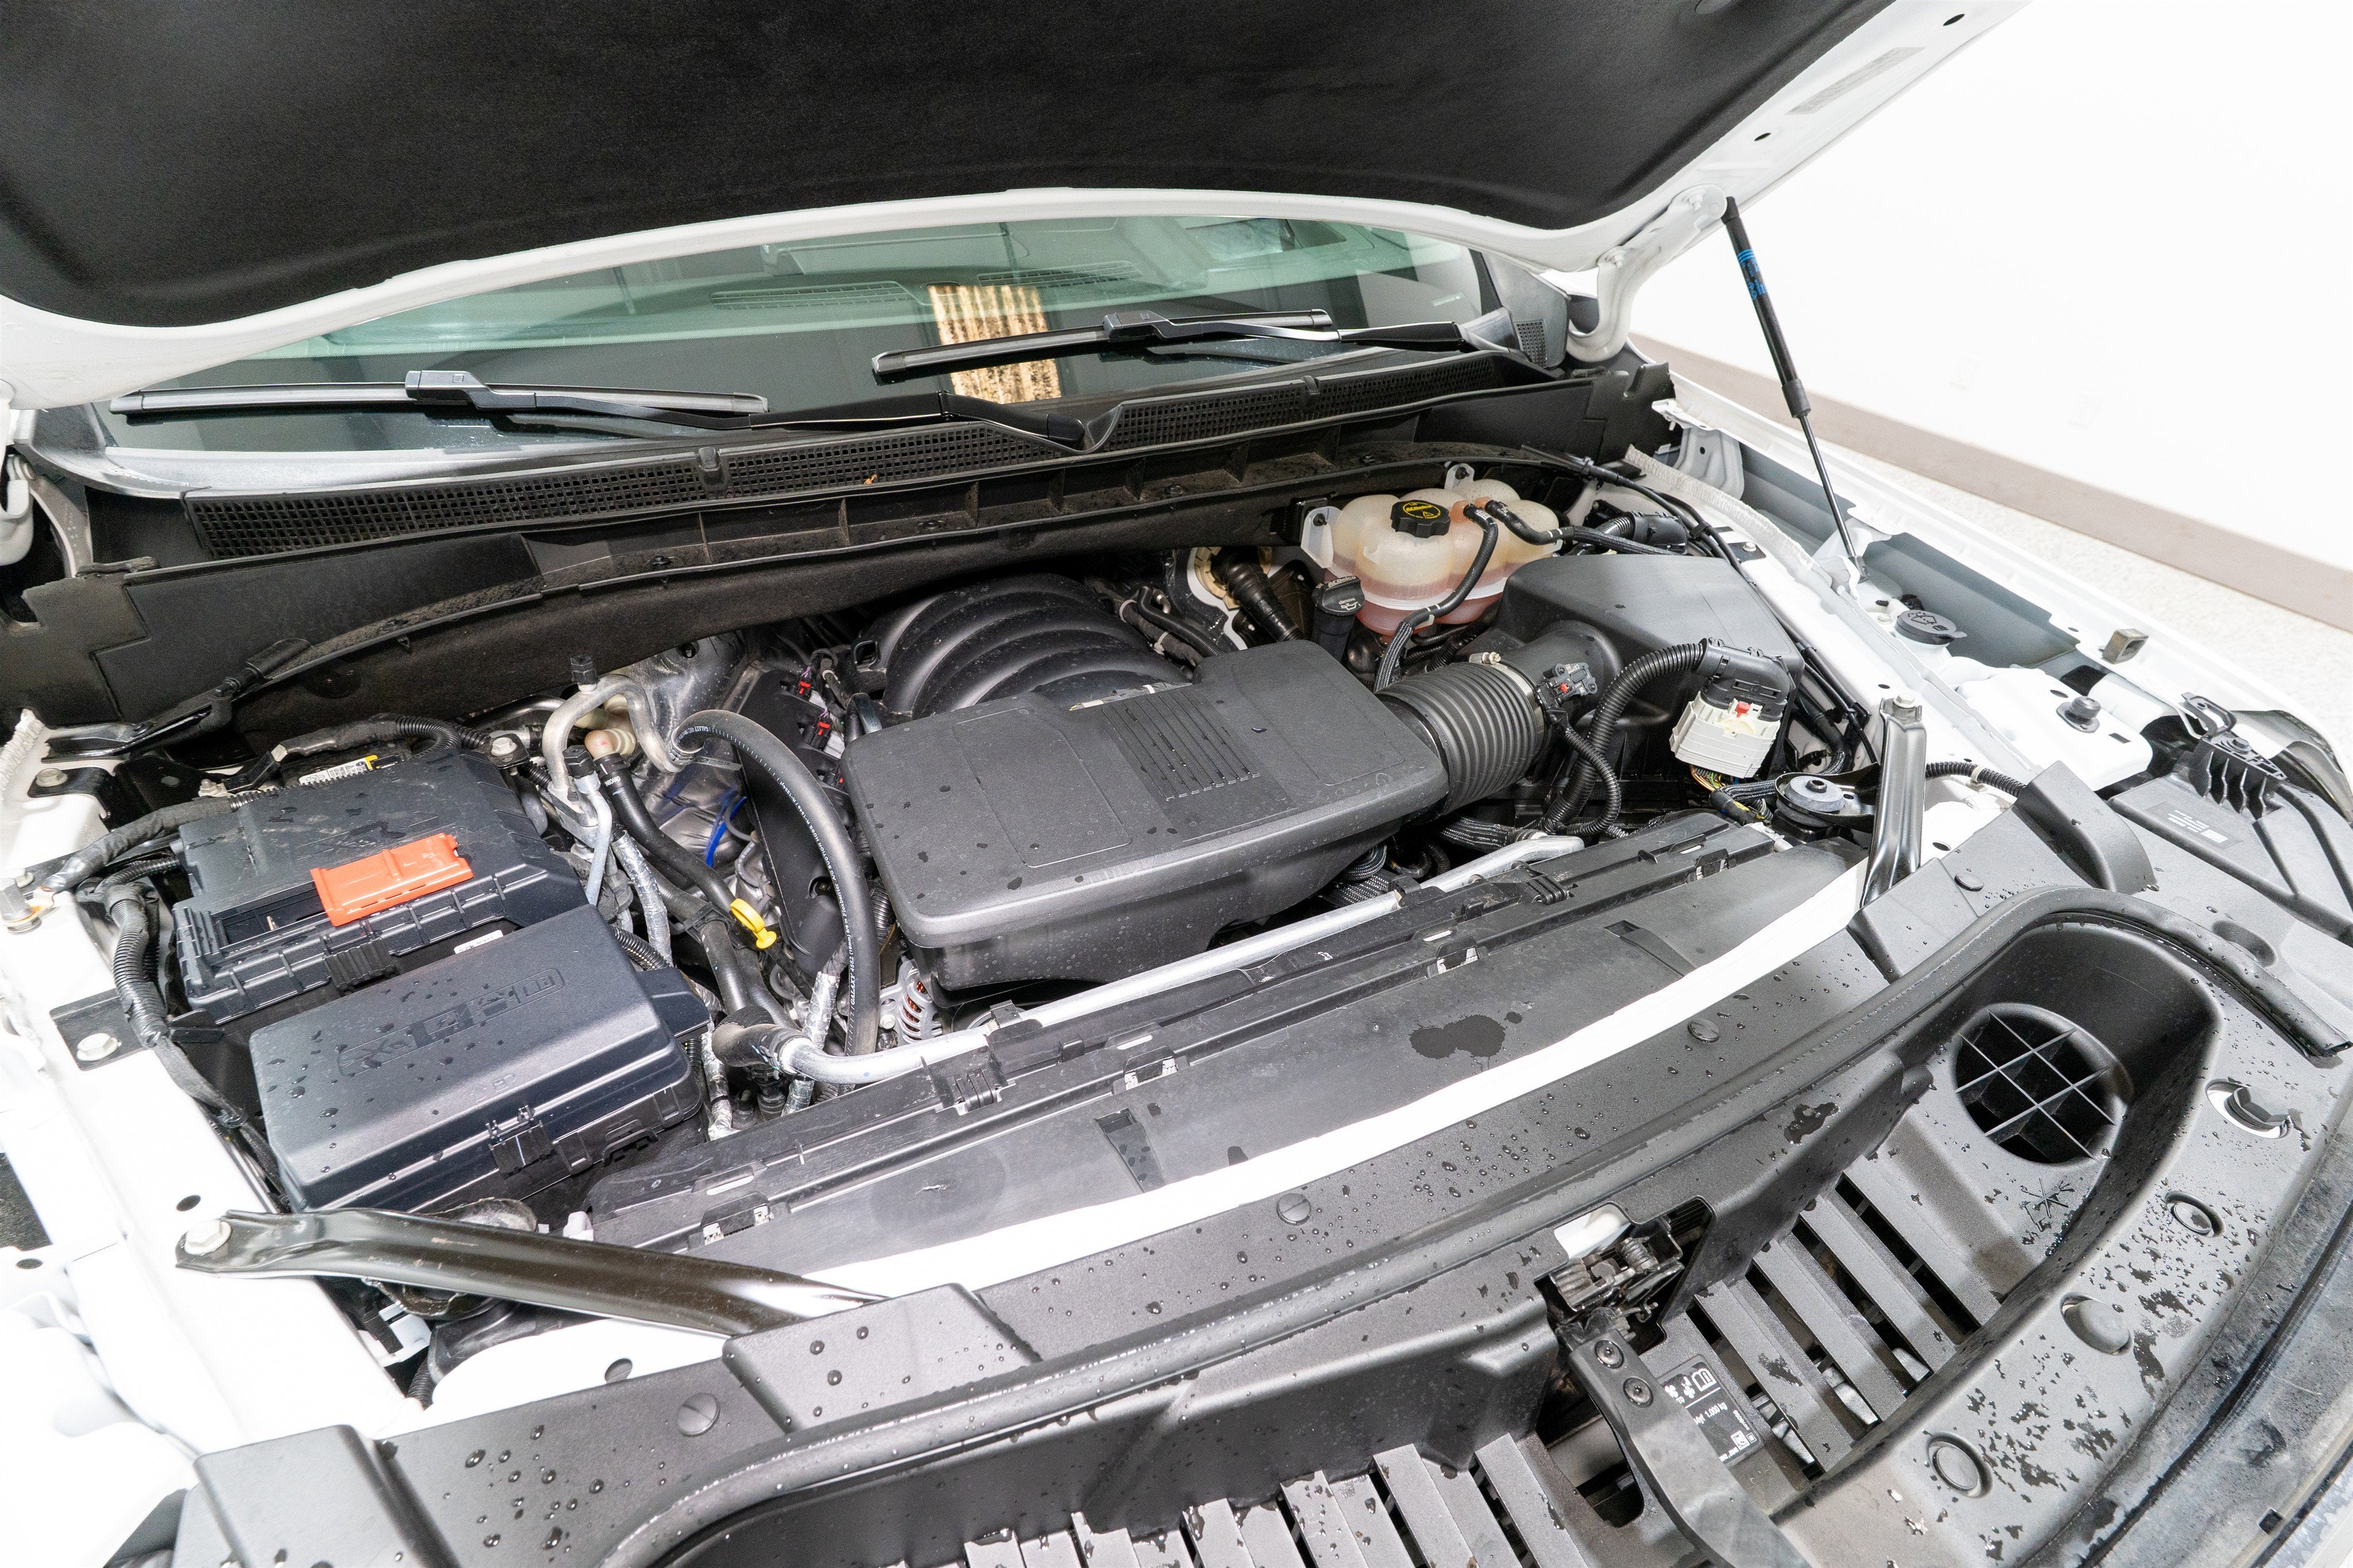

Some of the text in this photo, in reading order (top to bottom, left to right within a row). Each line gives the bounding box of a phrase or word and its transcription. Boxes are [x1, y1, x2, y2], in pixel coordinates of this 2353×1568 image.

[1328, 576, 1356, 588] ACDelco
[809, 825, 820, 842] HOSE
[818, 842, 832, 869] SUCTION
[835, 883, 847, 917] Flexbarrier
[1676, 1396, 1685, 1404] TO
[1704, 1405, 1721, 1418] 1.000
[1717, 1402, 1728, 1411] kg
